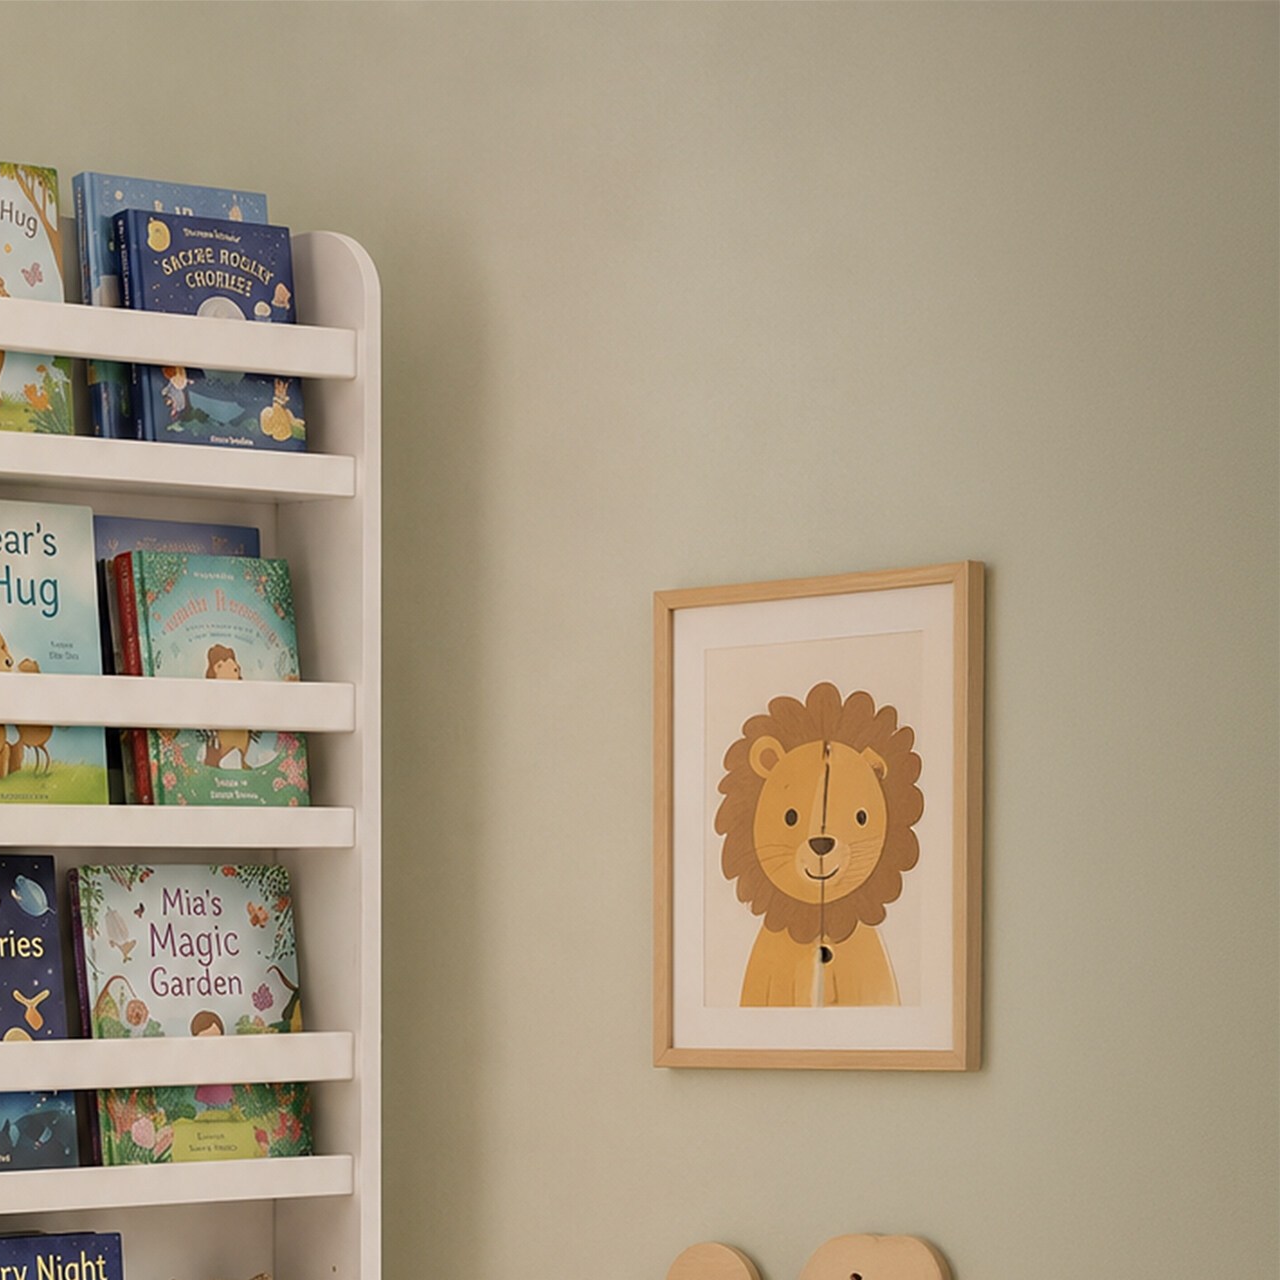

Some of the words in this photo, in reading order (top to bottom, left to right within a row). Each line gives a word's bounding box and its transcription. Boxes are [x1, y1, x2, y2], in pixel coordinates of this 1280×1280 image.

[0, 200, 38, 238] Hug
[162, 887, 223, 916] Mia's
[150, 922, 240, 967] Magic
[150, 966, 243, 997] Garden
